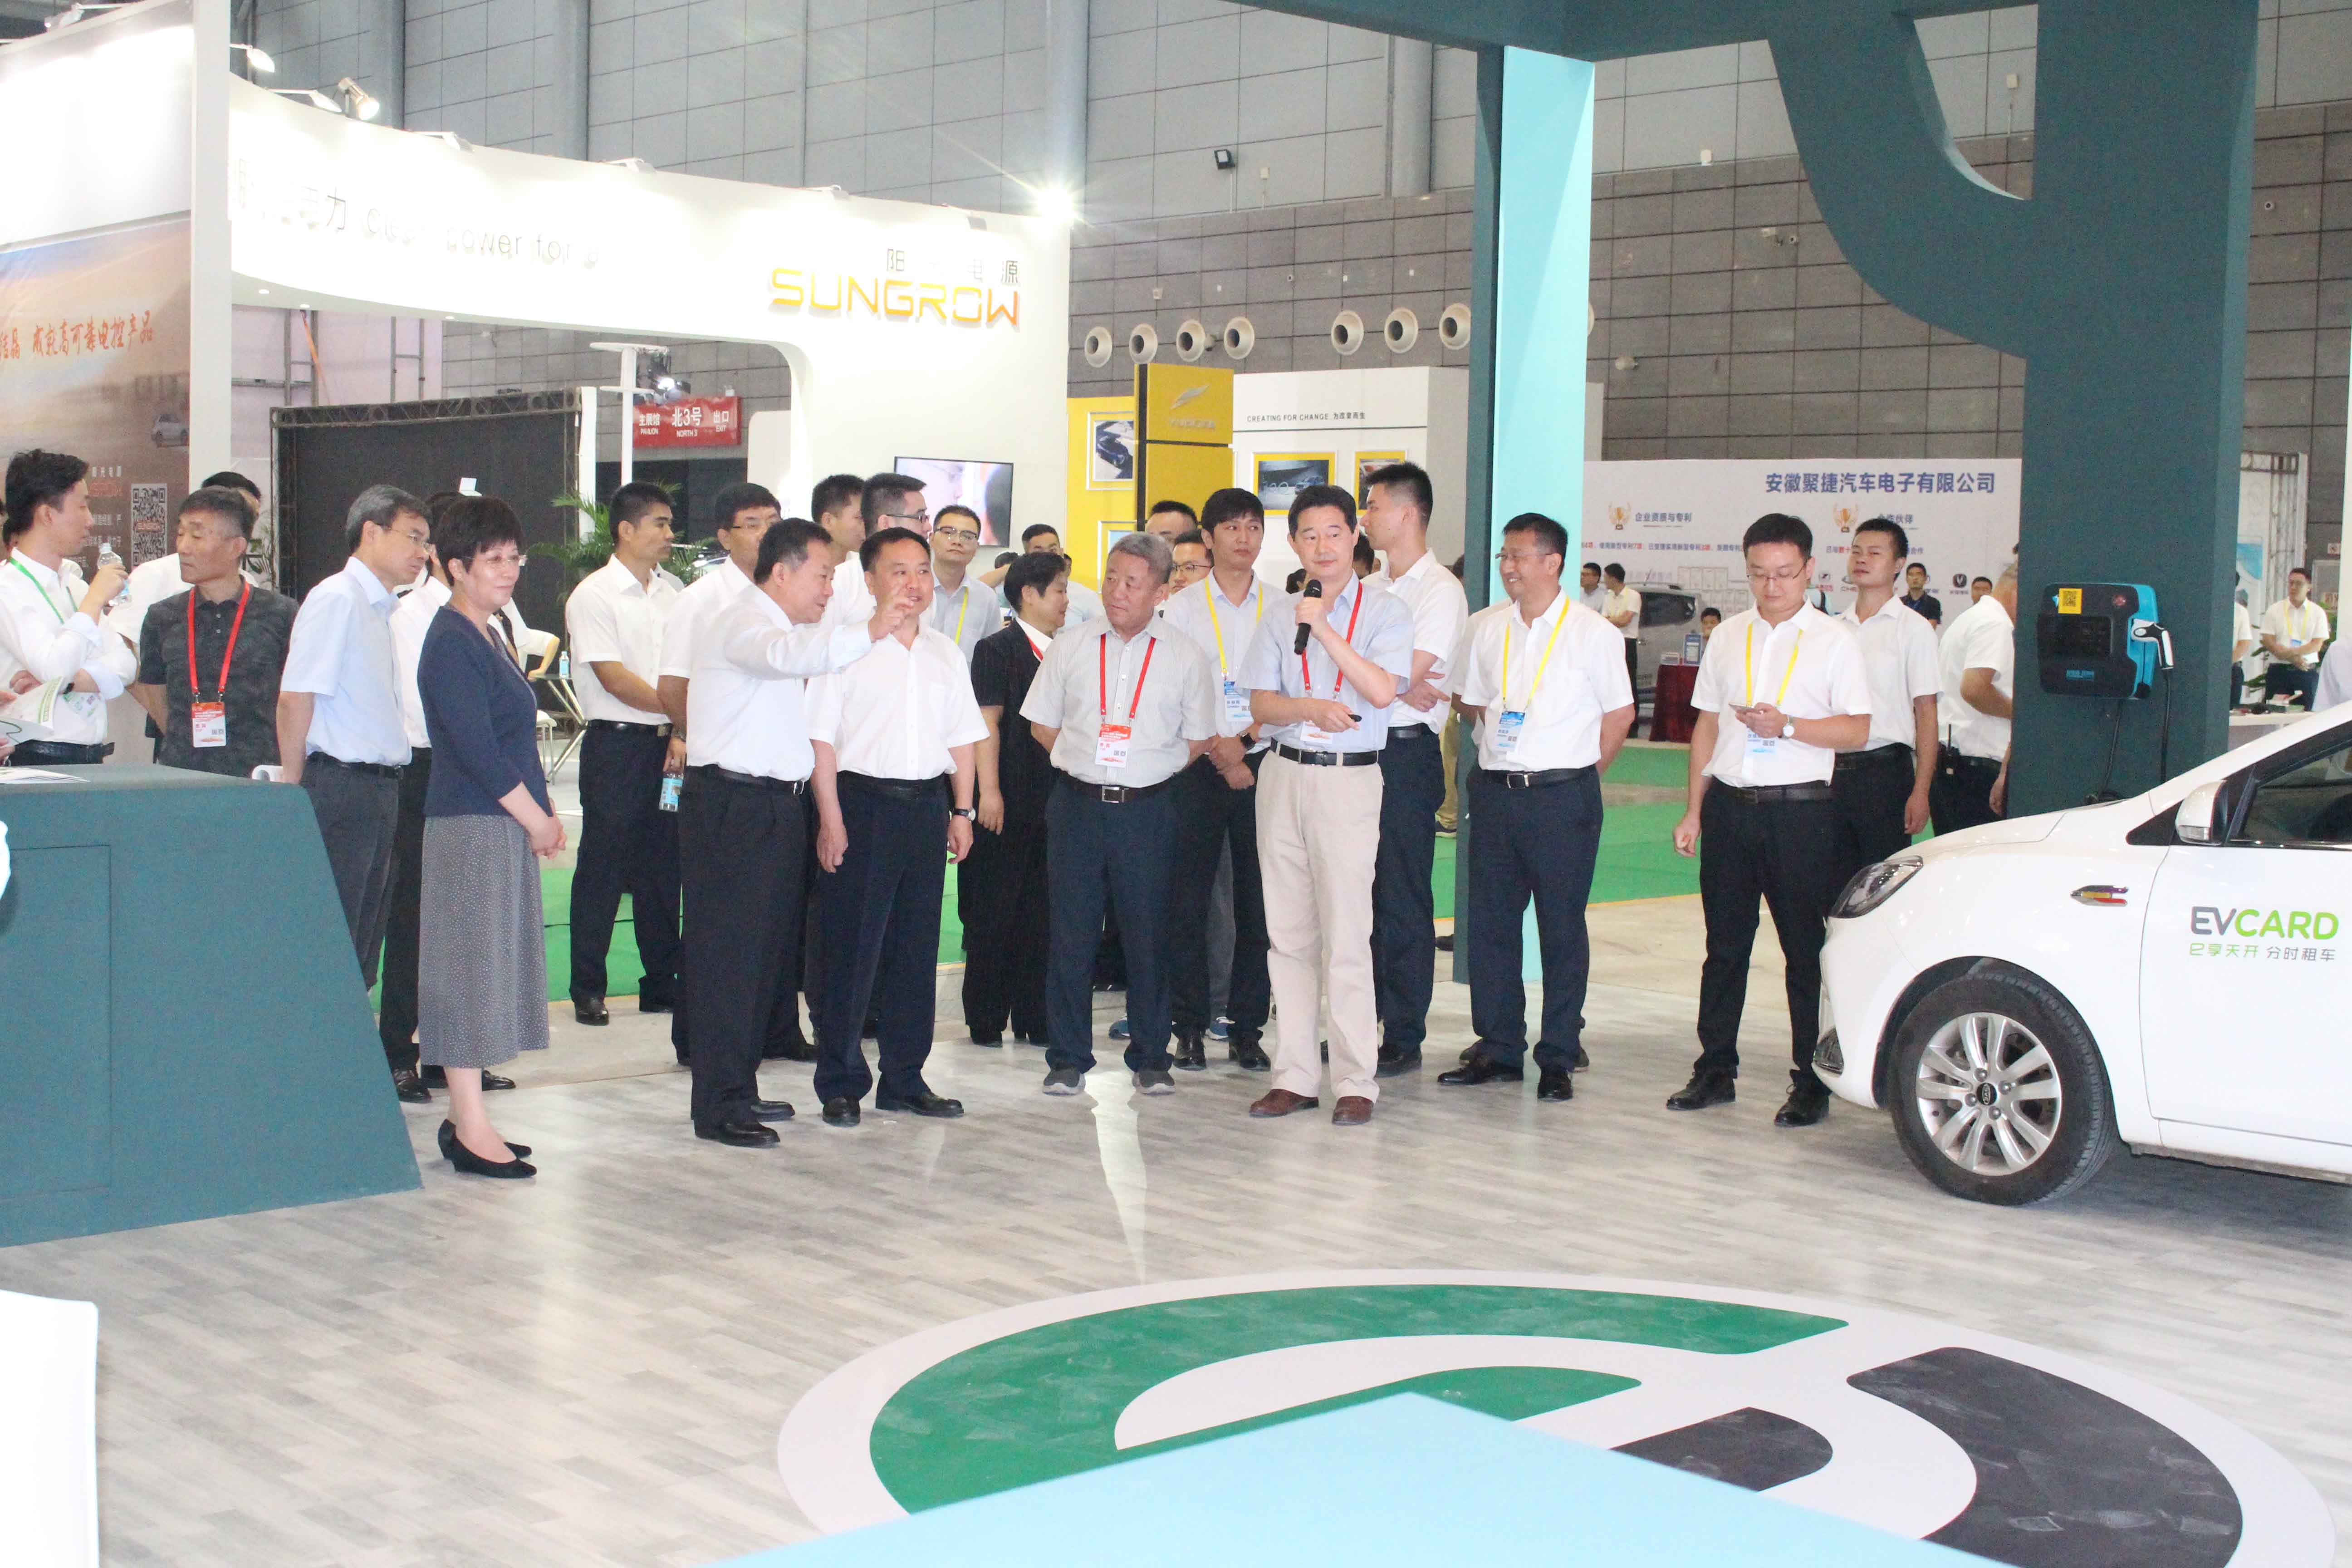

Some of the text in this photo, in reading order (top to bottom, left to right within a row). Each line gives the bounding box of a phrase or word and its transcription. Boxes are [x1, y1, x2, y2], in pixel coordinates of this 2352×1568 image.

[887, 248, 1019, 284] 阳电源
[771, 267, 1019, 327] SUNGROW
[638, 407, 730, 427] 主展馆 北3号 出口
[1299, 413, 1329, 421] CHANGE
[1765, 471, 1996, 494] 安徽聚捷汽车电子有限公司
[2191, 906, 2339, 940] EVCARD
[2266, 946, 2337, 962] 分时租车
